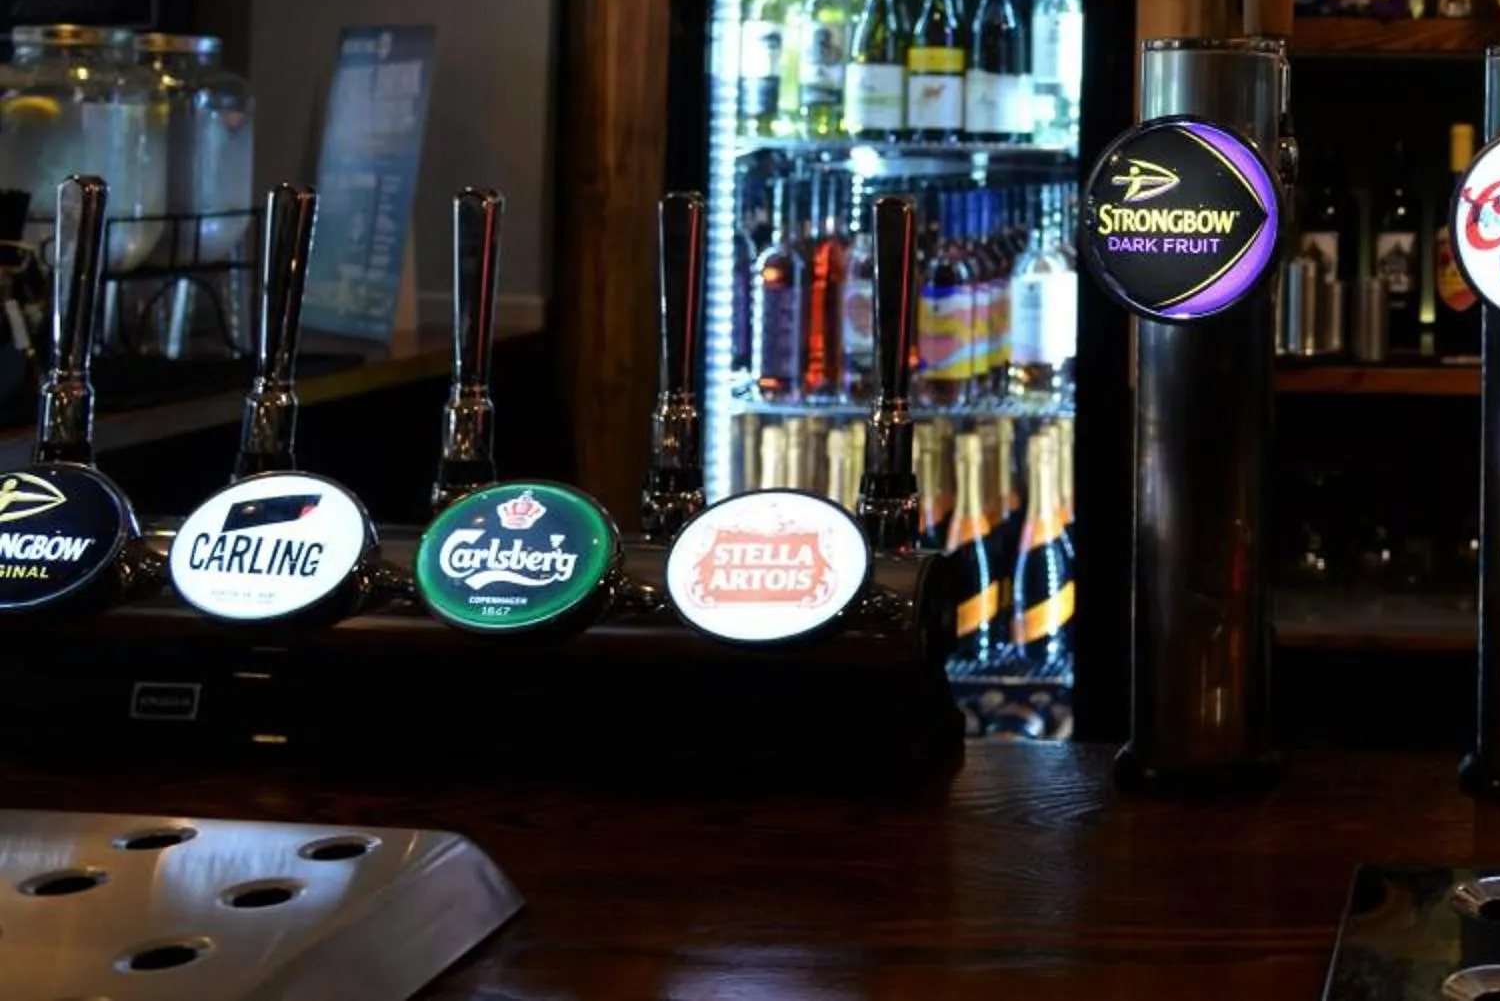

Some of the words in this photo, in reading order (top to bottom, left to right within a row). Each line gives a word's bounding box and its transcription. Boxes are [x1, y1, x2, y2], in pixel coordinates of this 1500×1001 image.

[1098, 204, 1235, 235] STRONGBOW
[1107, 236, 1158, 253] DARK
[1163, 238, 1221, 254] FRUIT
[0, 532, 92, 561] NGBOW
[189, 532, 323, 576] CARLING
[439, 529, 578, 582] Carlsberg
[713, 543, 813, 565] STELLA
[709, 568, 814, 590] ARTOIS
